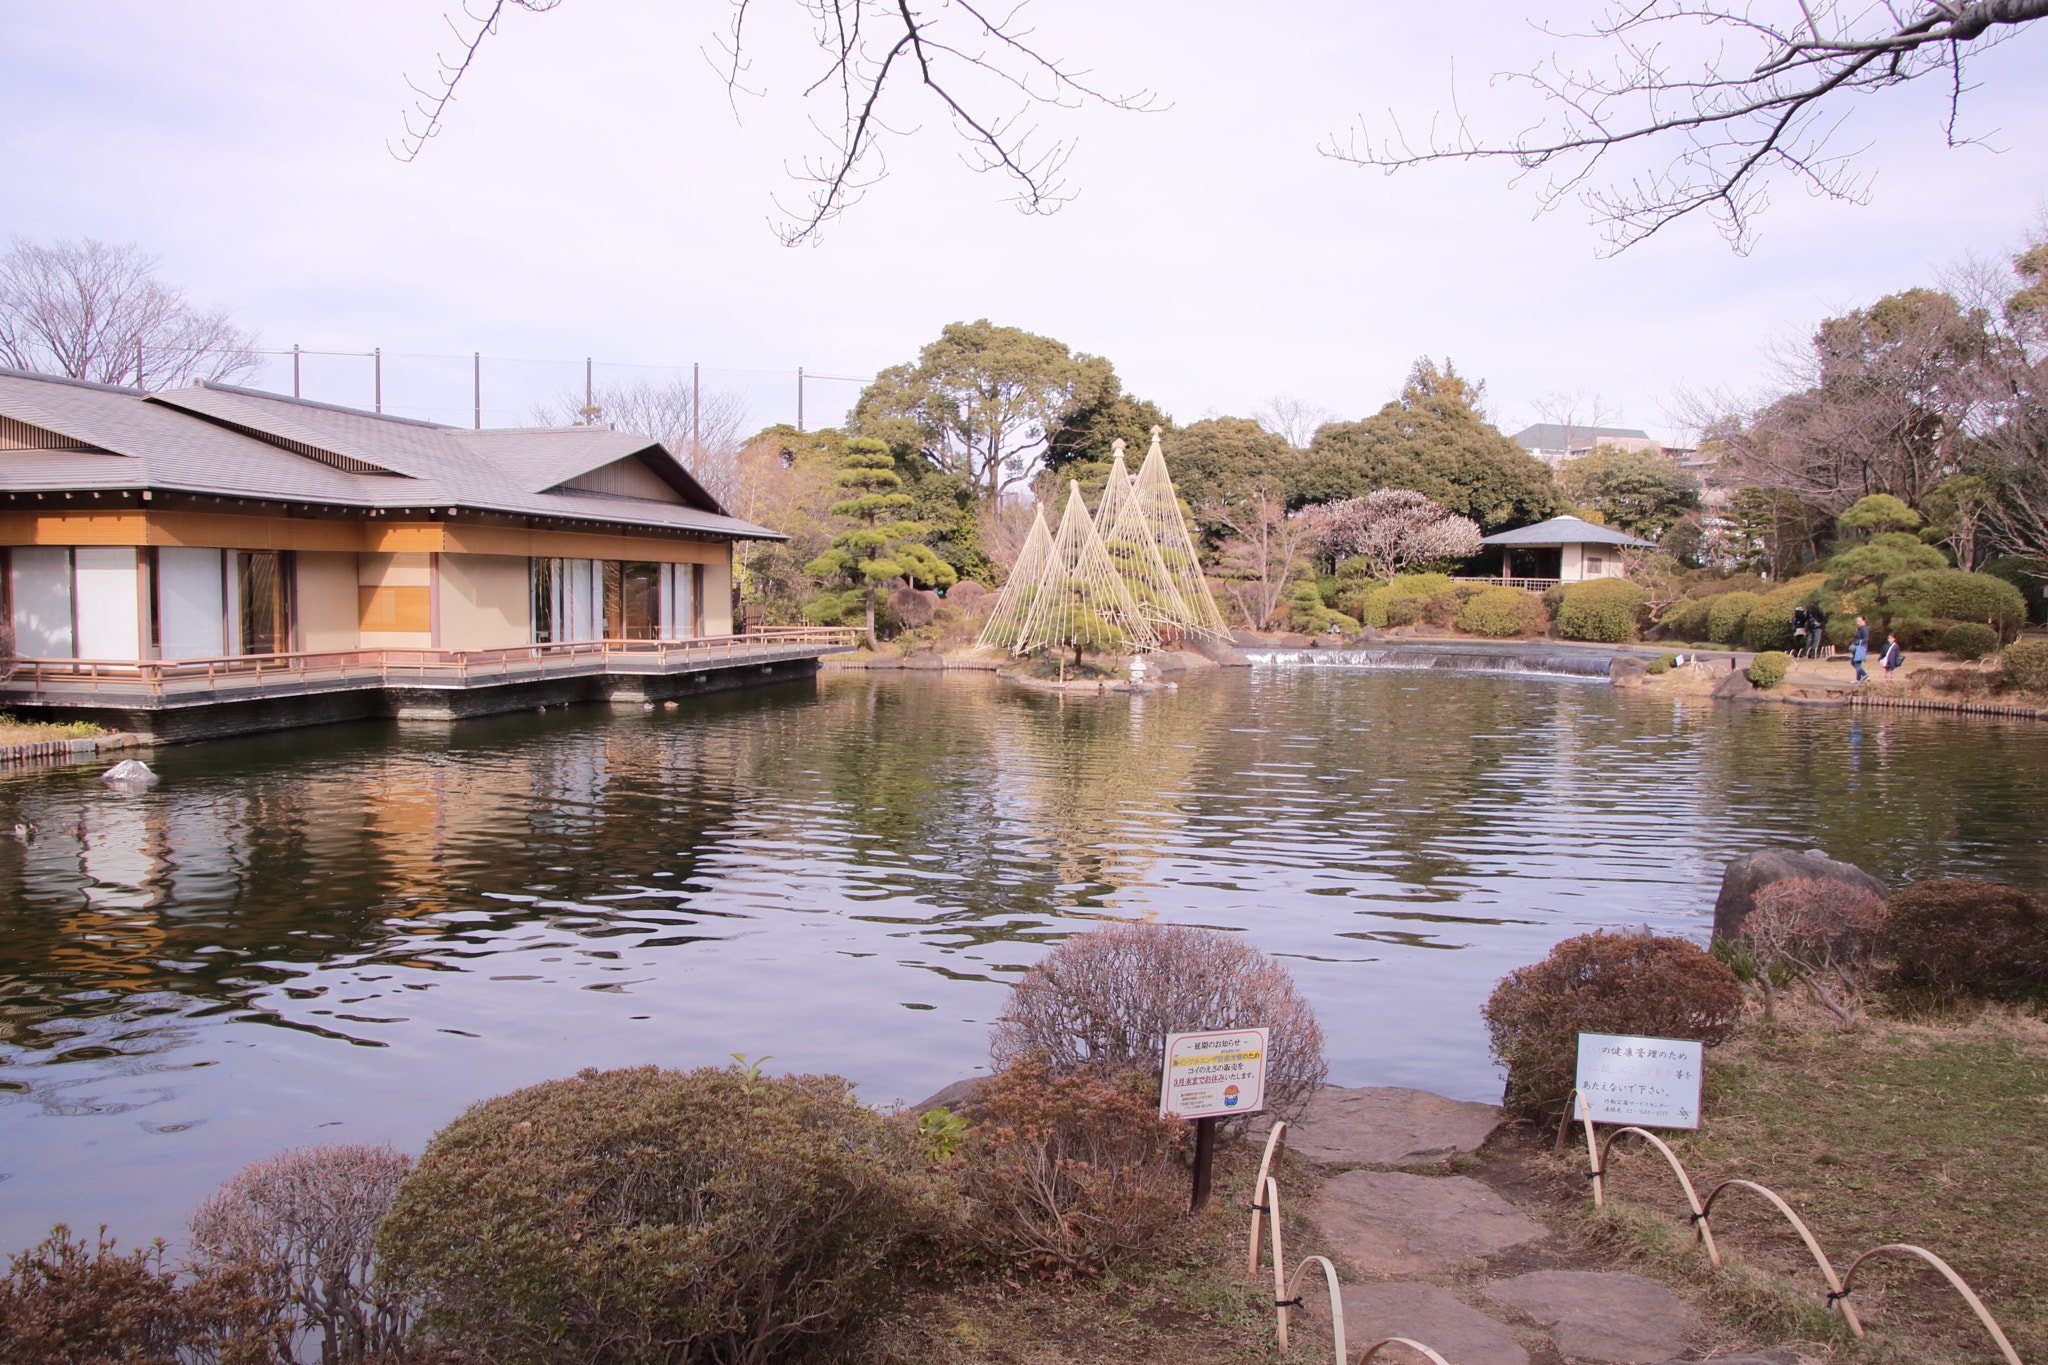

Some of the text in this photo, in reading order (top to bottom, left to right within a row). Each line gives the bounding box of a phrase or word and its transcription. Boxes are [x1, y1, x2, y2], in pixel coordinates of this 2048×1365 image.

[1582, 1081, 1669, 1097] あたえないで下さい。
